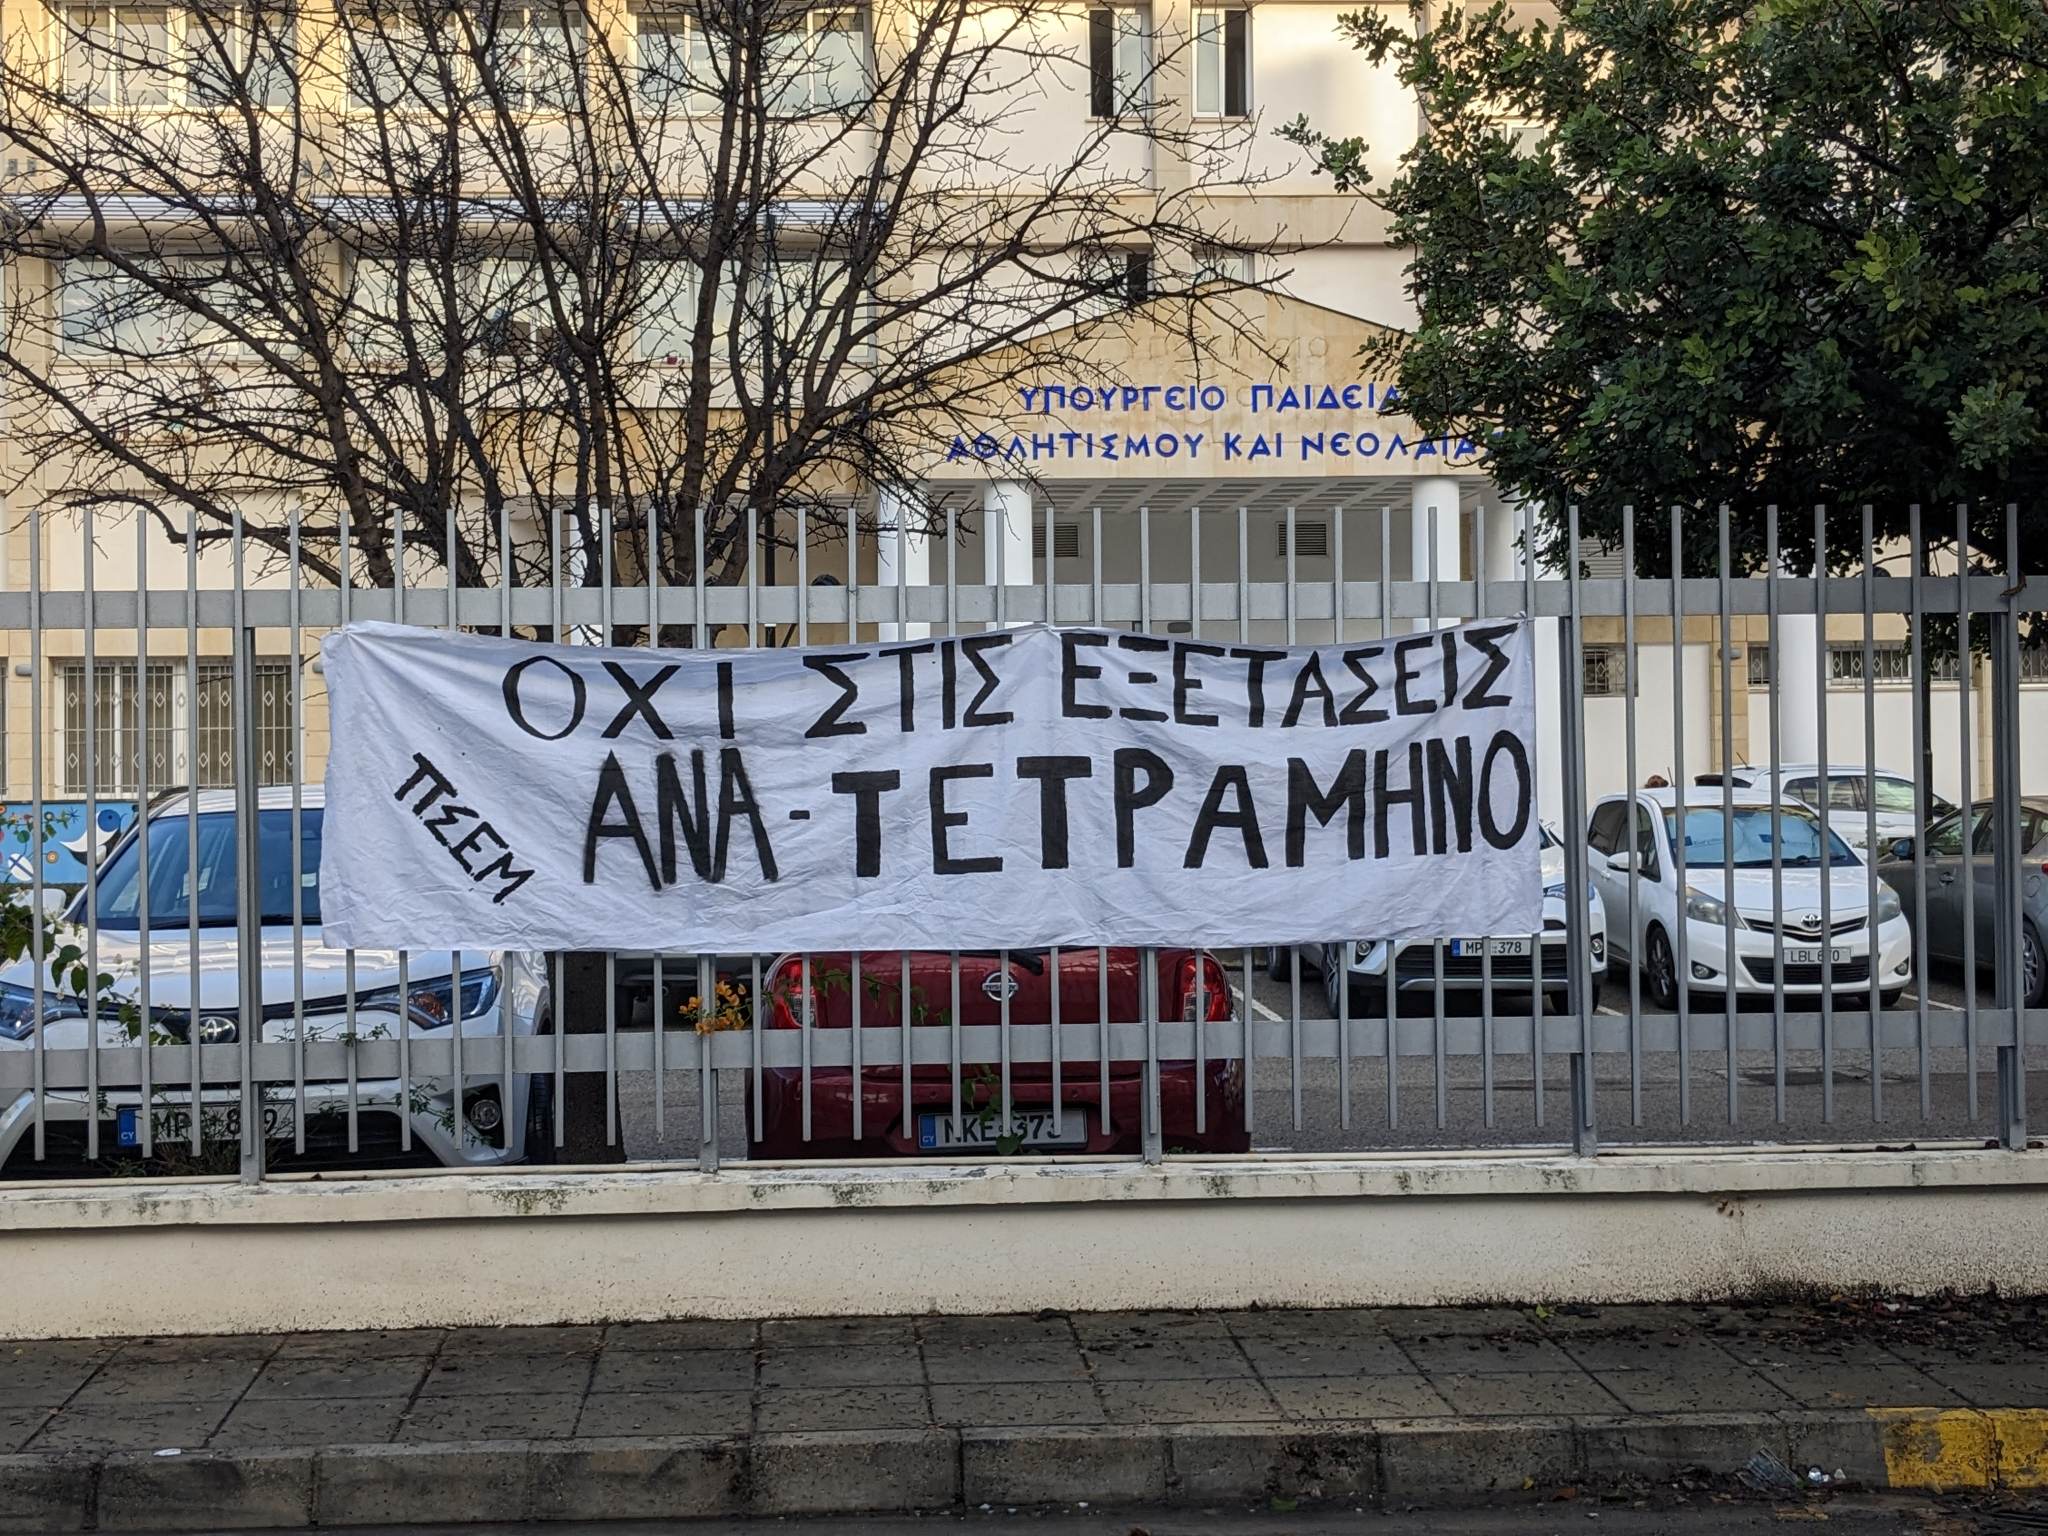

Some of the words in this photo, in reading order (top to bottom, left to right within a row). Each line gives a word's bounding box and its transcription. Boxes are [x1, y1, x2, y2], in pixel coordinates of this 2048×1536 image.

[1017, 385, 1226, 414] ΥΠΟΥΡΓΕΙΟ
[1251, 383, 1402, 413] ΠΑΙΔΕΙΑ
[946, 431, 1204, 462] ΑΘΛΗΤΙΣΜΟΥ
[1225, 431, 1282, 461] ΚΑΙ
[1301, 430, 1504, 461] ΝΕΟΛΑΙΑ
[502, 655, 734, 740] ΟΧΙ
[803, 634, 1014, 738] ΣΤΙΣ
[1061, 623, 1518, 727] ΕΞΕΤΑΣΕΙΣ
[1498, 941, 1522, 954] 378
[1790, 950, 1815, 963] LBL
[227, 1108, 278, 1135] 89
[120, 1131, 135, 1140] CY
[922, 1135, 934, 1143] CY
